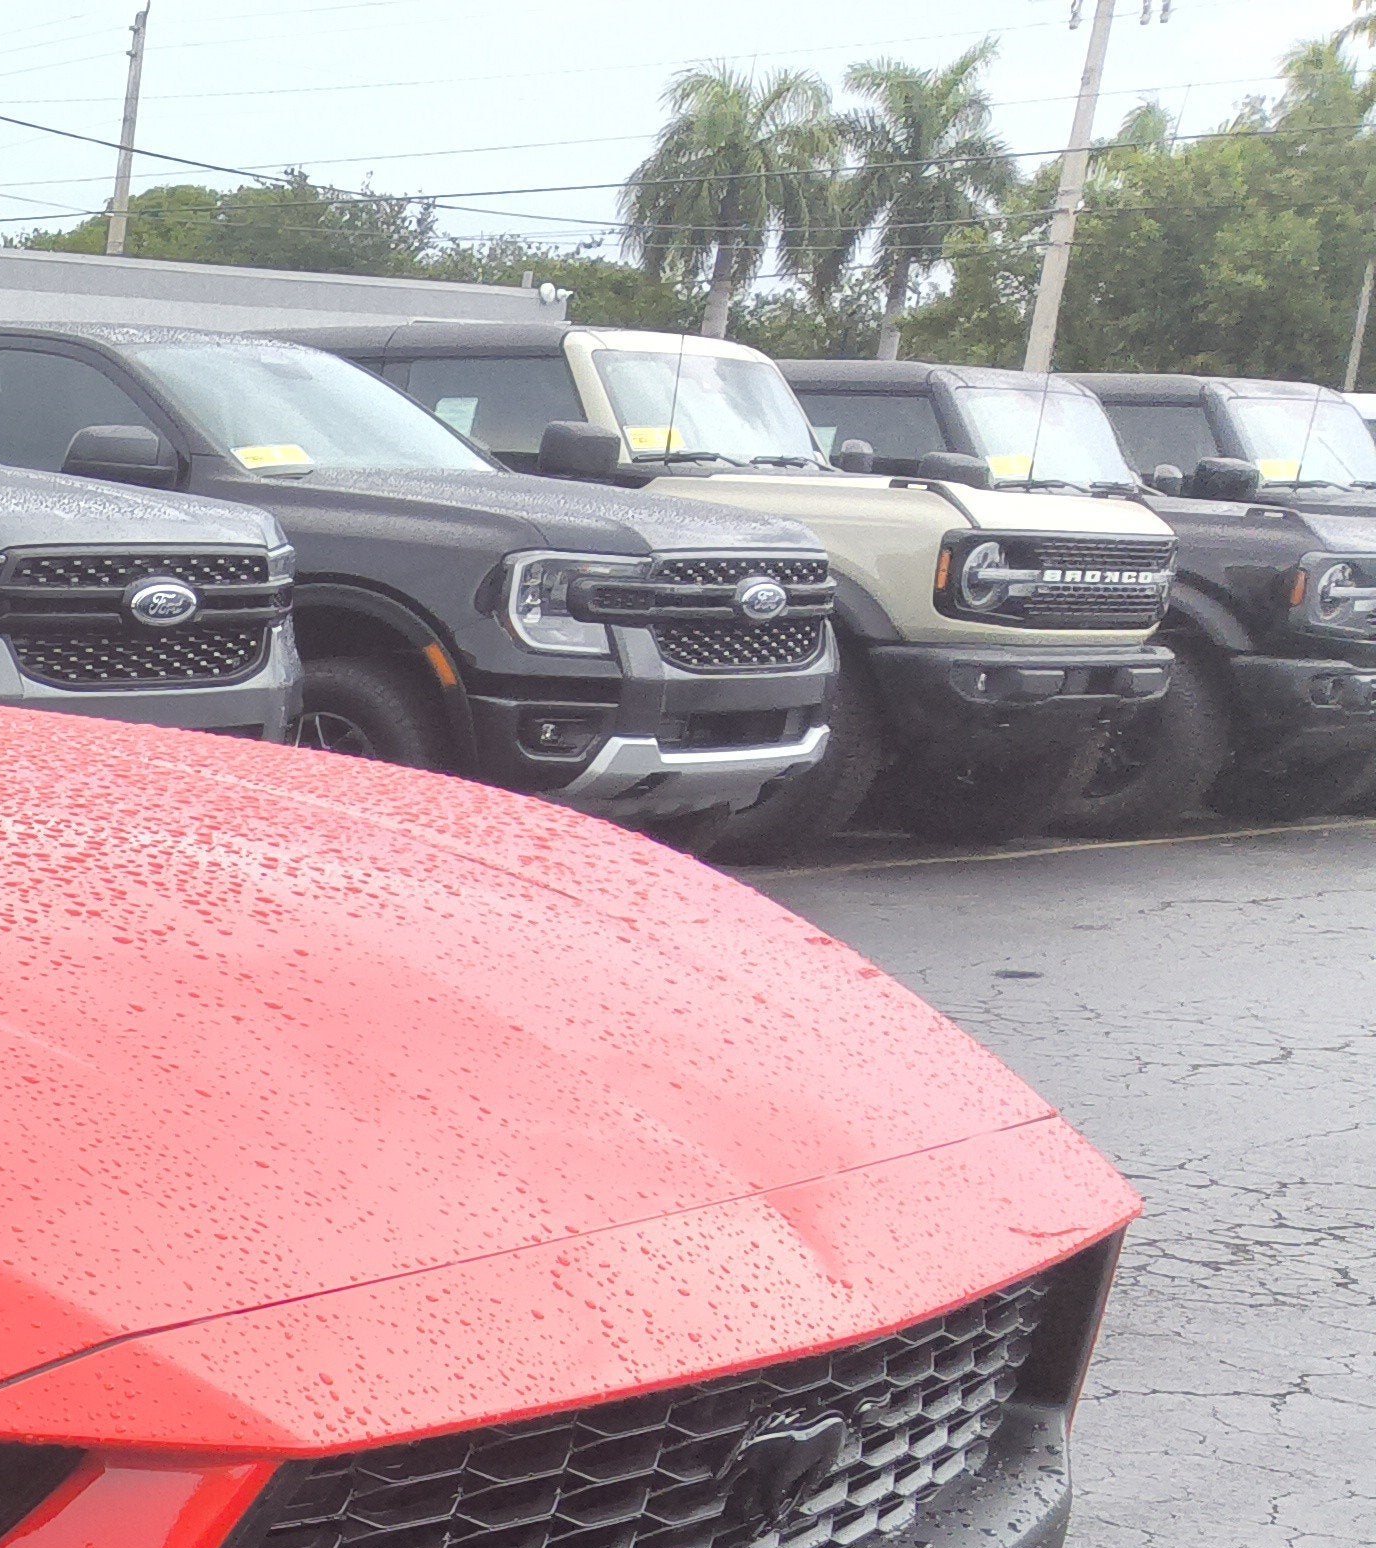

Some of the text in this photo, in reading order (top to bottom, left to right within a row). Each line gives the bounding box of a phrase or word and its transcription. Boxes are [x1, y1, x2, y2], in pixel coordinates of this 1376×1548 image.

[1043, 569, 1153, 583] BRONCO
[148, 592, 186, 615] Ford
[753, 590, 782, 610] Ford
